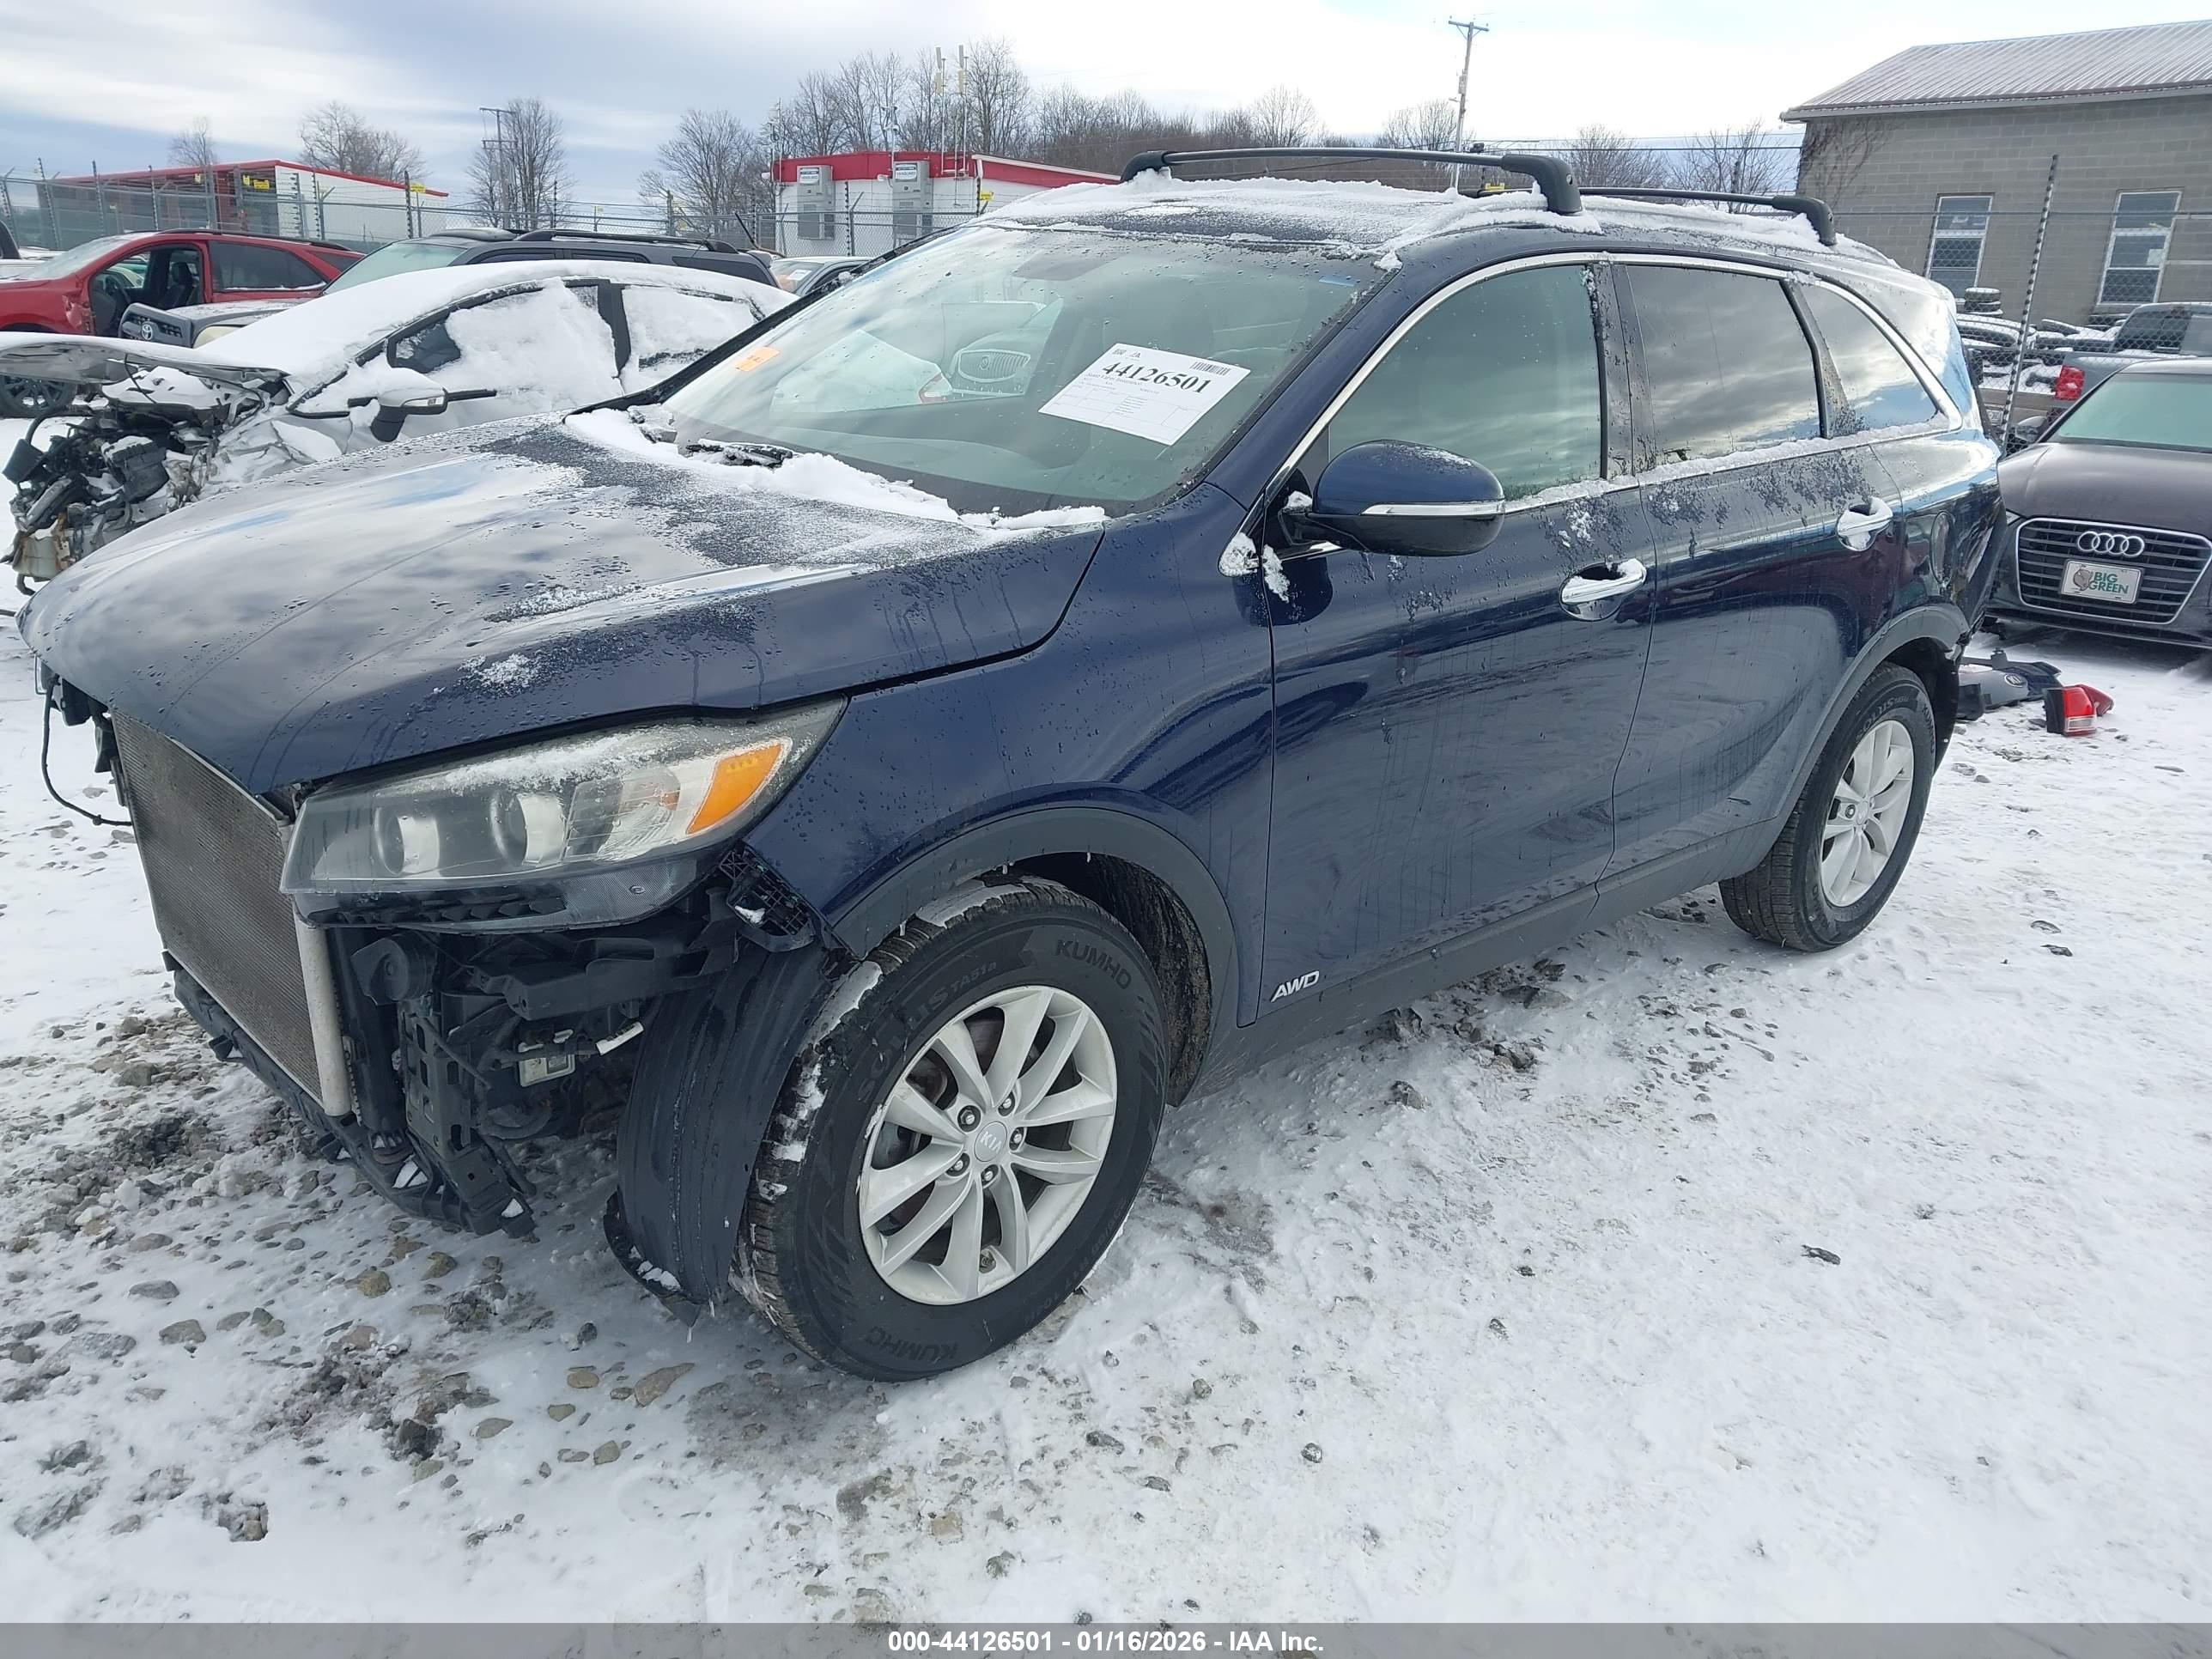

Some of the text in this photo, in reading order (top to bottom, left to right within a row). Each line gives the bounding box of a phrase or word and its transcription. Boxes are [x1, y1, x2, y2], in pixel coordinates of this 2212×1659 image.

[1103, 362, 1212, 393] 44126501
[2088, 580, 2130, 594] GREEN
[2094, 571, 2118, 583] BIG
[1055, 939, 1132, 988] KUMHO
[1270, 970, 1320, 1003] AWD
[980, 1131, 1002, 1154] KIA
[864, 1326, 960, 1363] KUMHO
